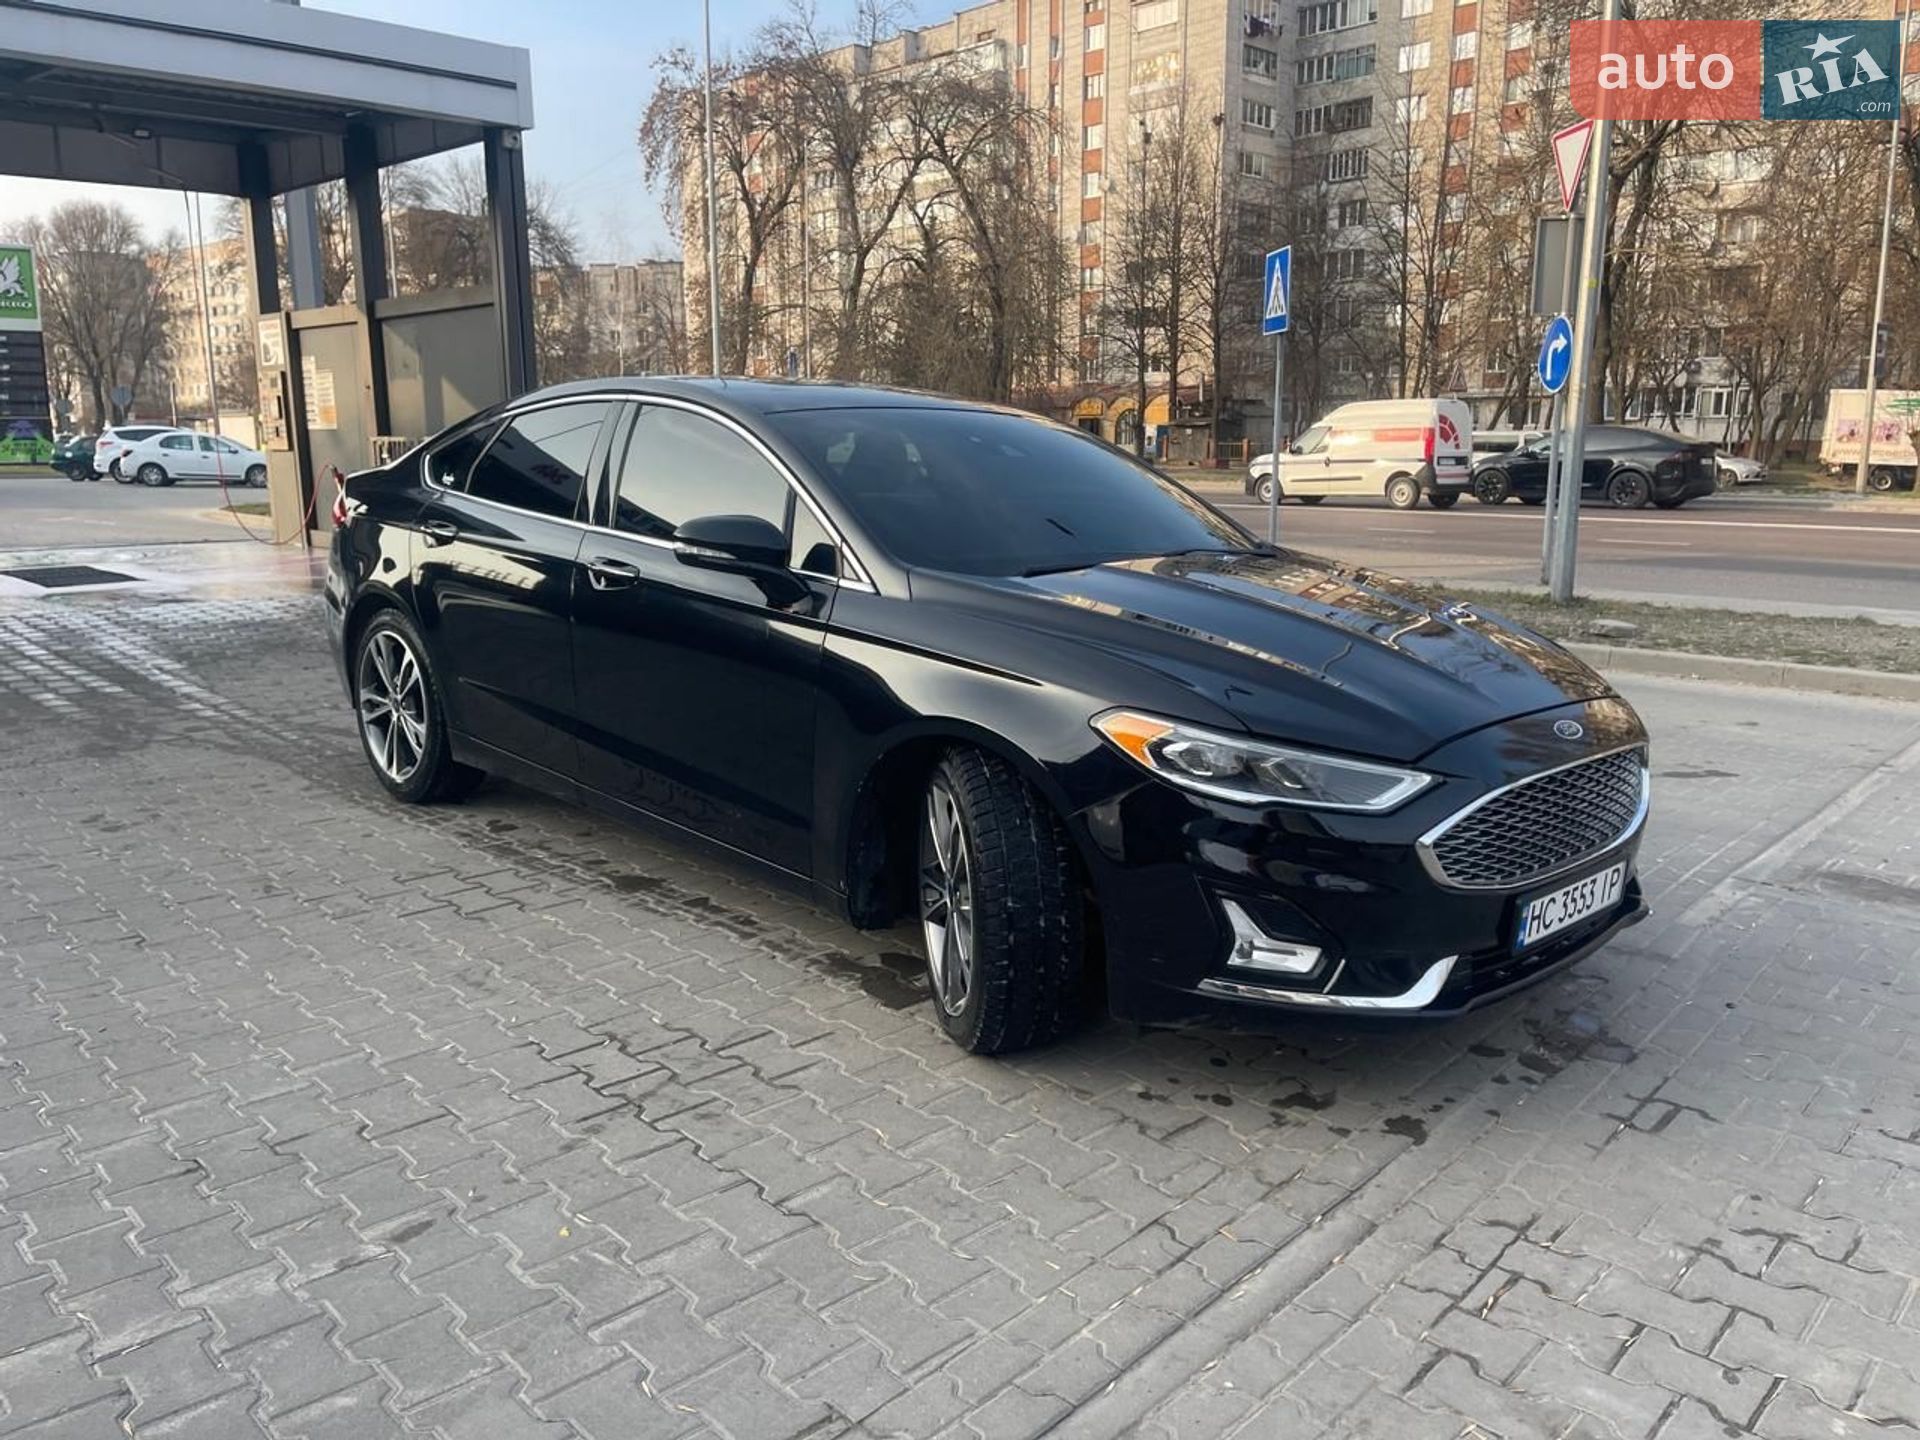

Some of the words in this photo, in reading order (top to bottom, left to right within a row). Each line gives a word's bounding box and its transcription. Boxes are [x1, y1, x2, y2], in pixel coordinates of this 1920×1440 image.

[1527, 897, 1556, 938] HC
[1558, 878, 1597, 923] 3553
[1601, 867, 1620, 903] IP
